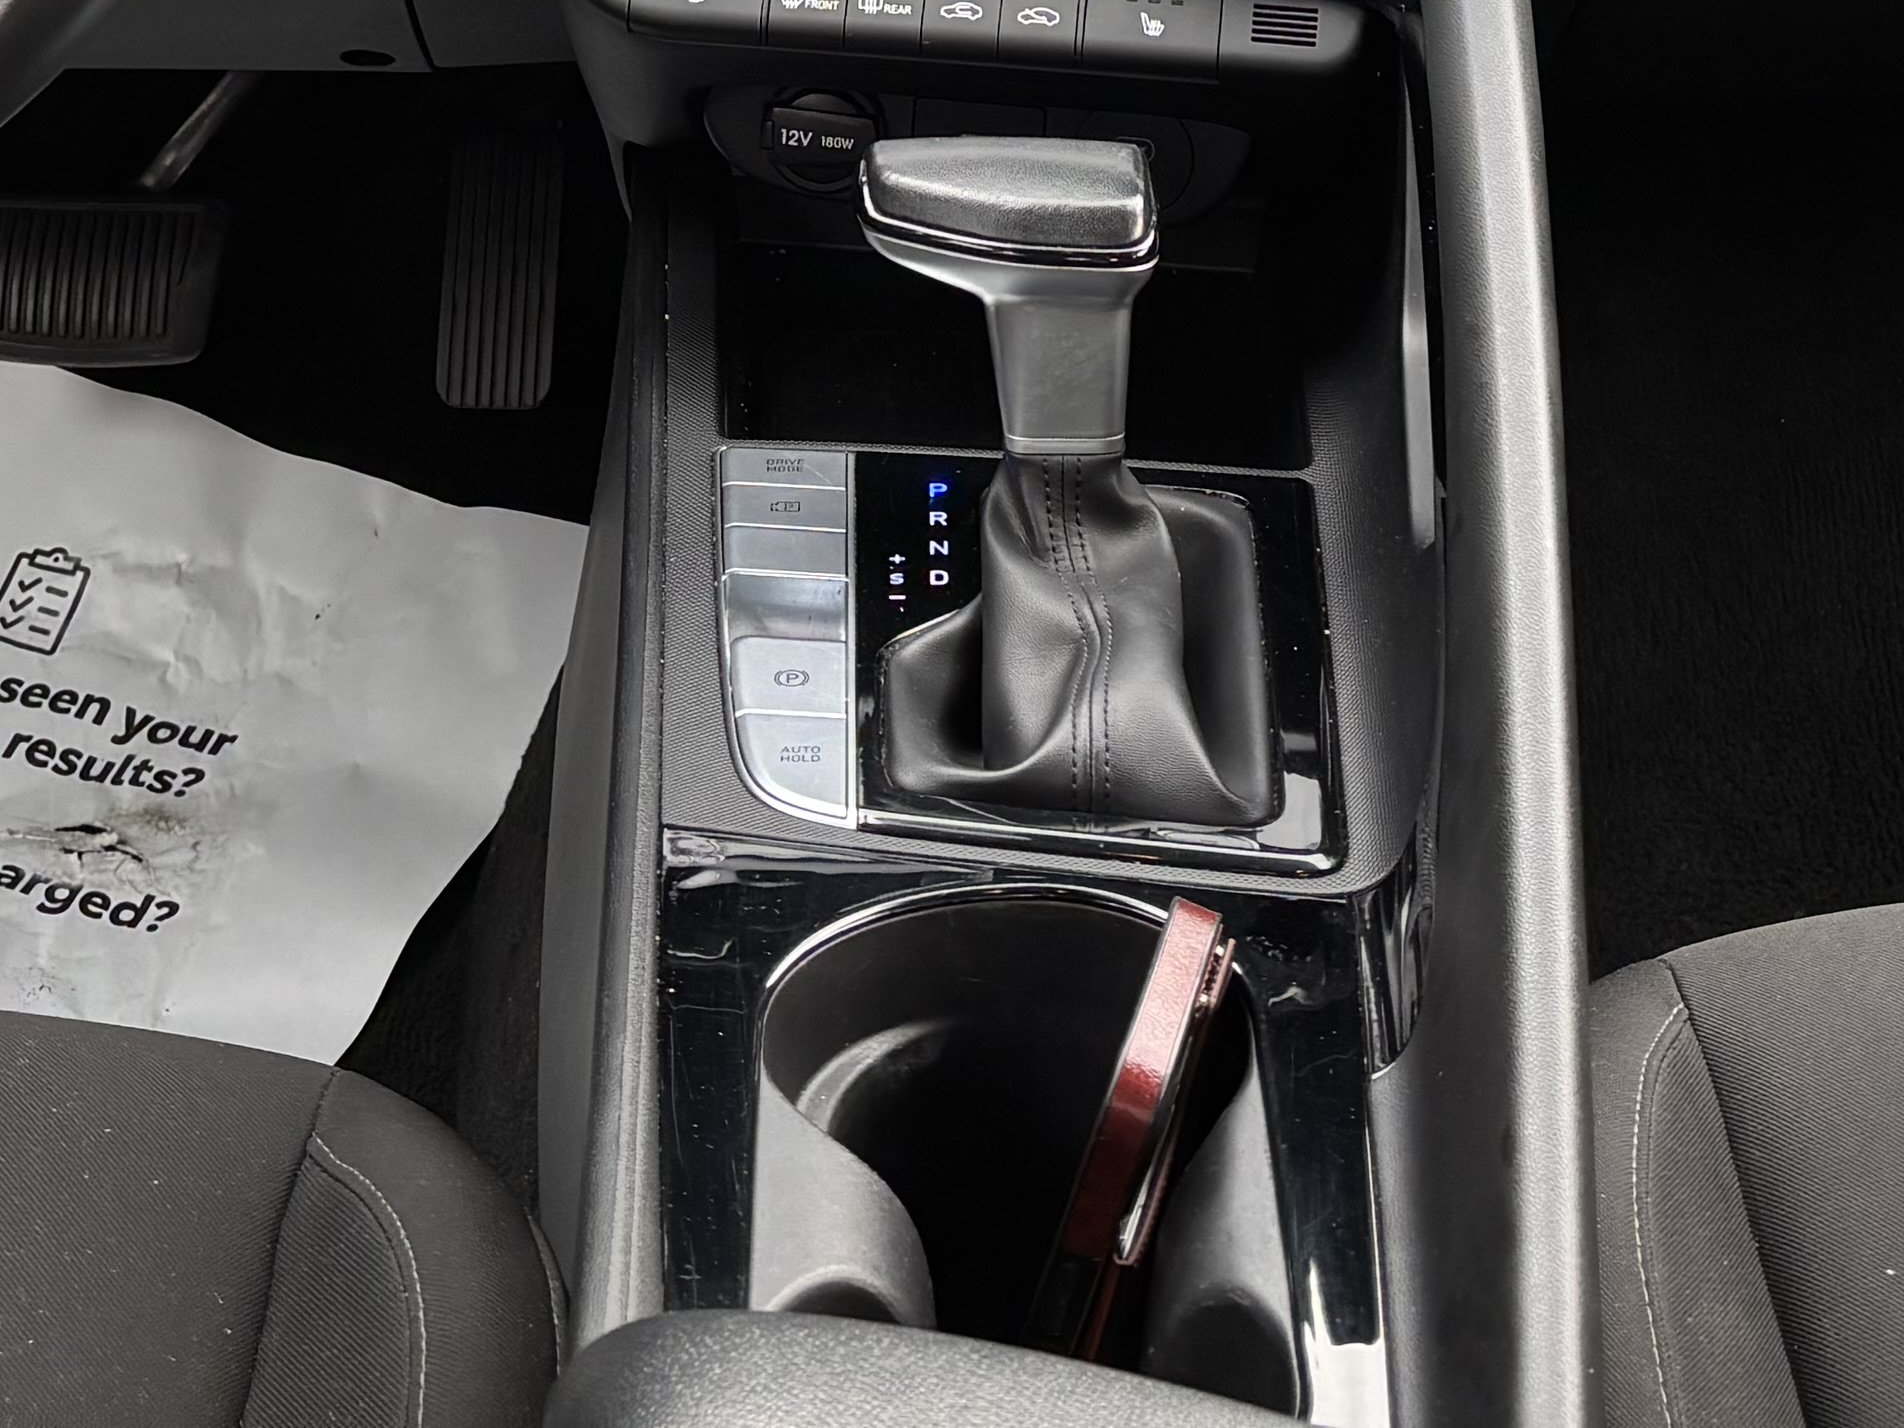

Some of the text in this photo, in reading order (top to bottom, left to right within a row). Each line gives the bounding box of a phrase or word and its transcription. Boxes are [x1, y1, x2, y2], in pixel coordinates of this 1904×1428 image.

[804, 0, 840, 12] FRONT
[883, 2, 912, 16] REAR
[781, 128, 855, 150] 12V 180W
[766, 458, 805, 466] DRIVE
[766, 464, 804, 473] MODE
[928, 482, 948, 498] P
[928, 511, 948, 526] R
[929, 540, 949, 555] N
[889, 573, 904, 585] S
[929, 569, 950, 586] D
[110, 704, 240, 757] your
[779, 746, 821, 755] AUTO
[1, 730, 207, 799] results?
[779, 754, 821, 763] HOLD
